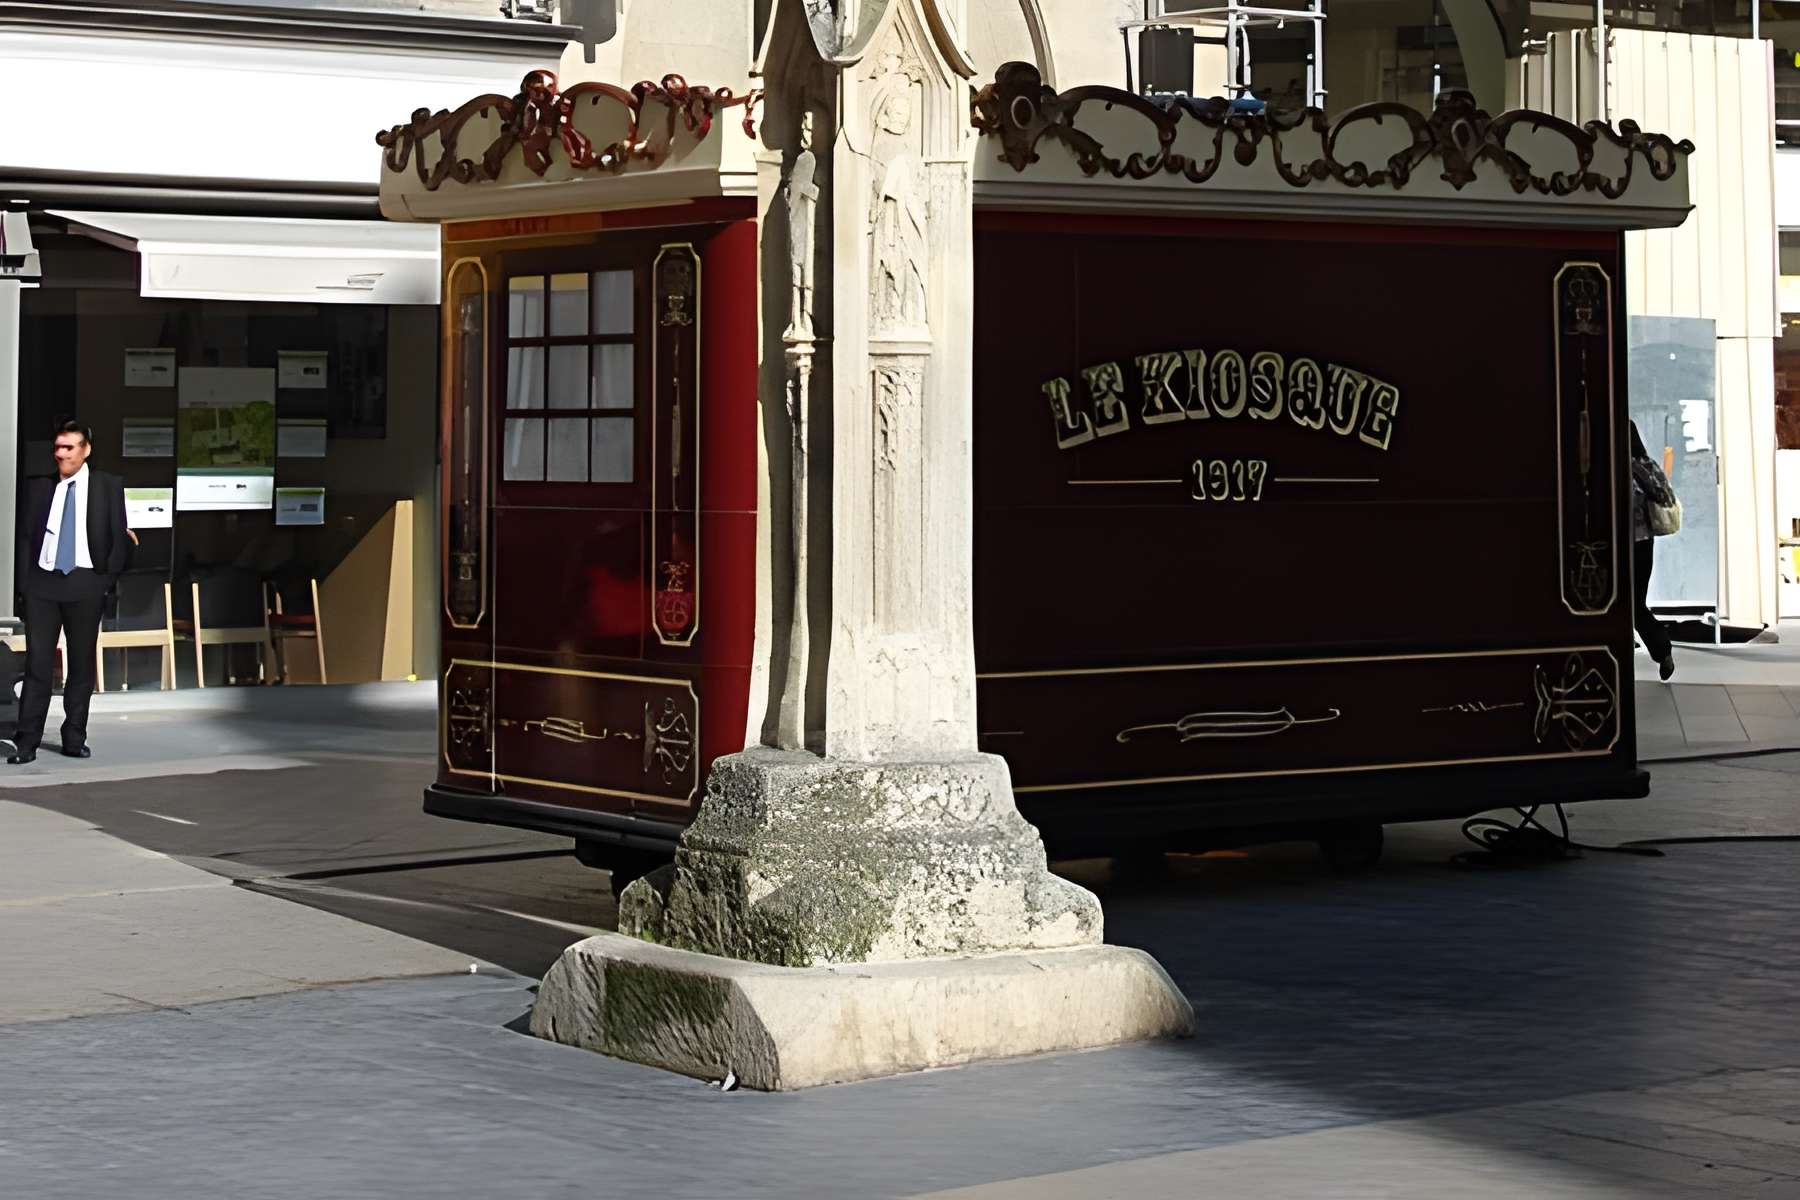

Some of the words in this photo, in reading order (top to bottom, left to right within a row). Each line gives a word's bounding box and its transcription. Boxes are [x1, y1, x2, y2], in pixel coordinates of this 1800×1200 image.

[1041, 361, 1130, 450] LE
[1134, 348, 1400, 451] KIOSQUE
[1191, 459, 1268, 501] 1917
